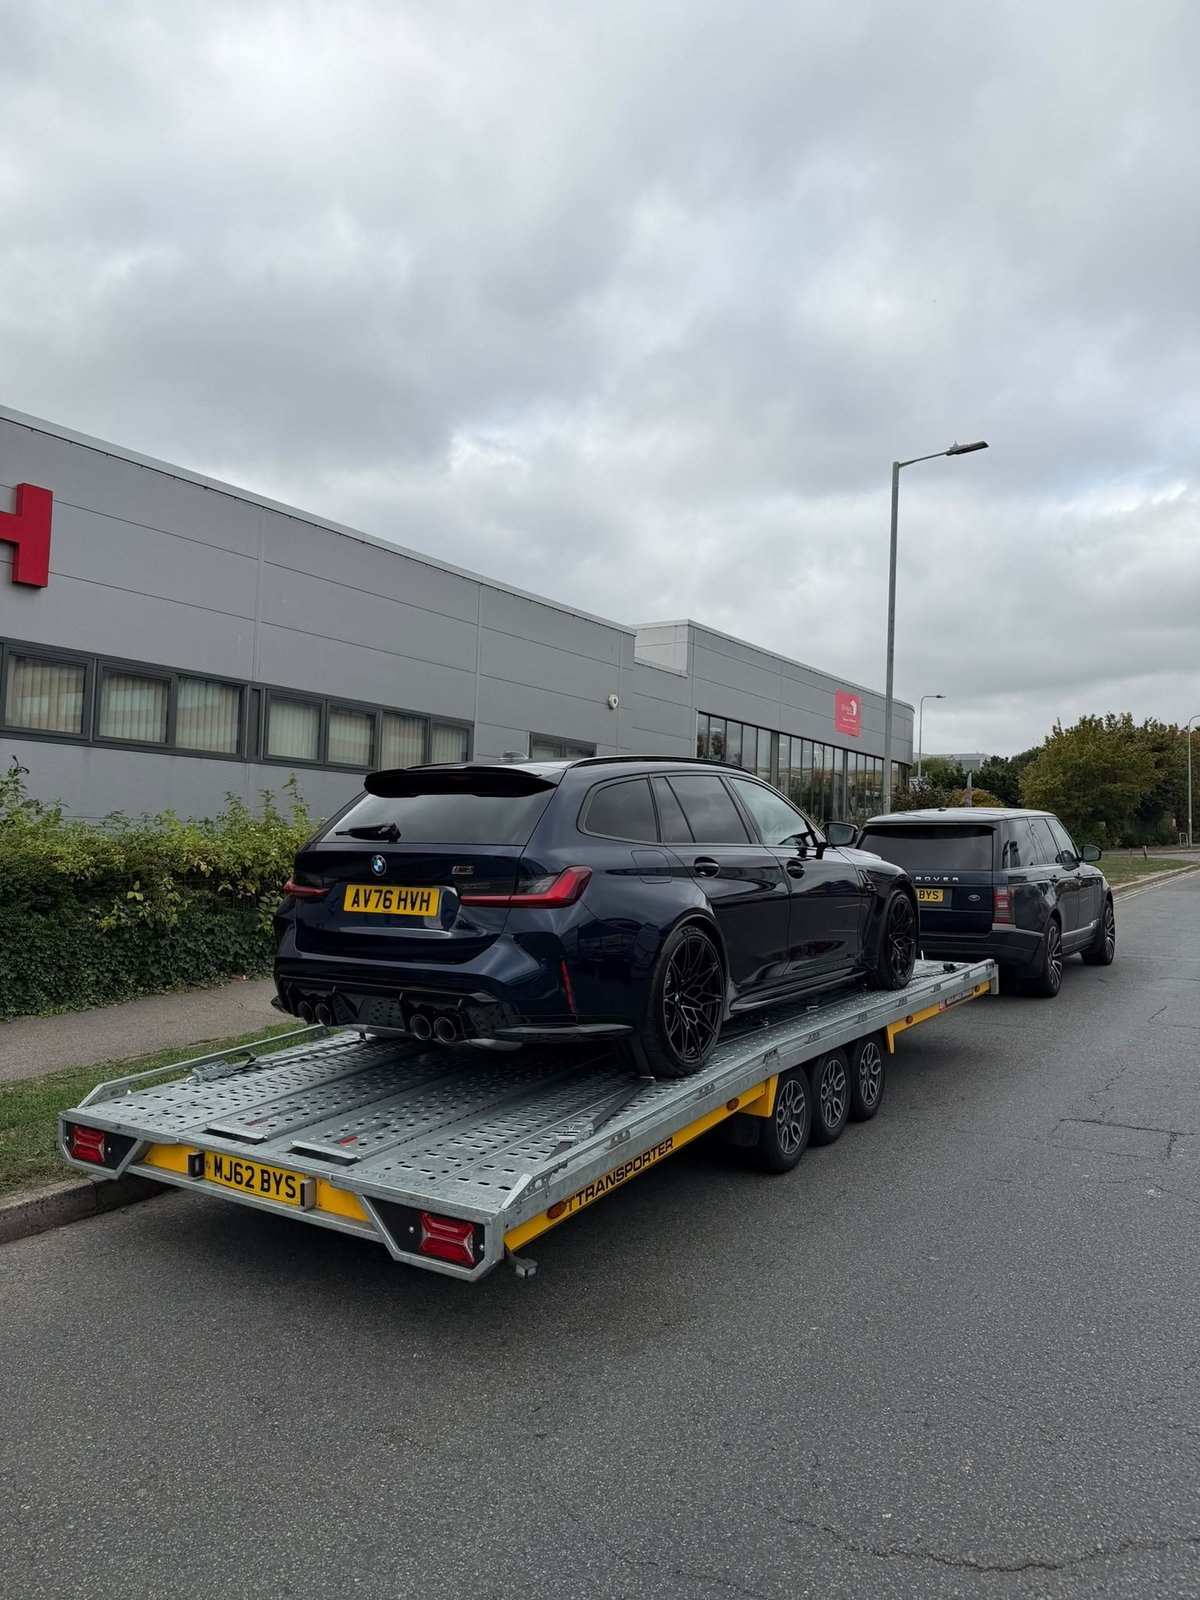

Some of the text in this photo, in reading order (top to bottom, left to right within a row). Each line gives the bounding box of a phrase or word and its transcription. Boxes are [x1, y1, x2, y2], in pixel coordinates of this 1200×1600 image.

[351, 888, 431, 912] AV76 HVH
[918, 889, 939, 900] BYS
[214, 1155, 297, 1199] MJ62 BYS
[575, 1137, 674, 1206] TRANSPORTER
